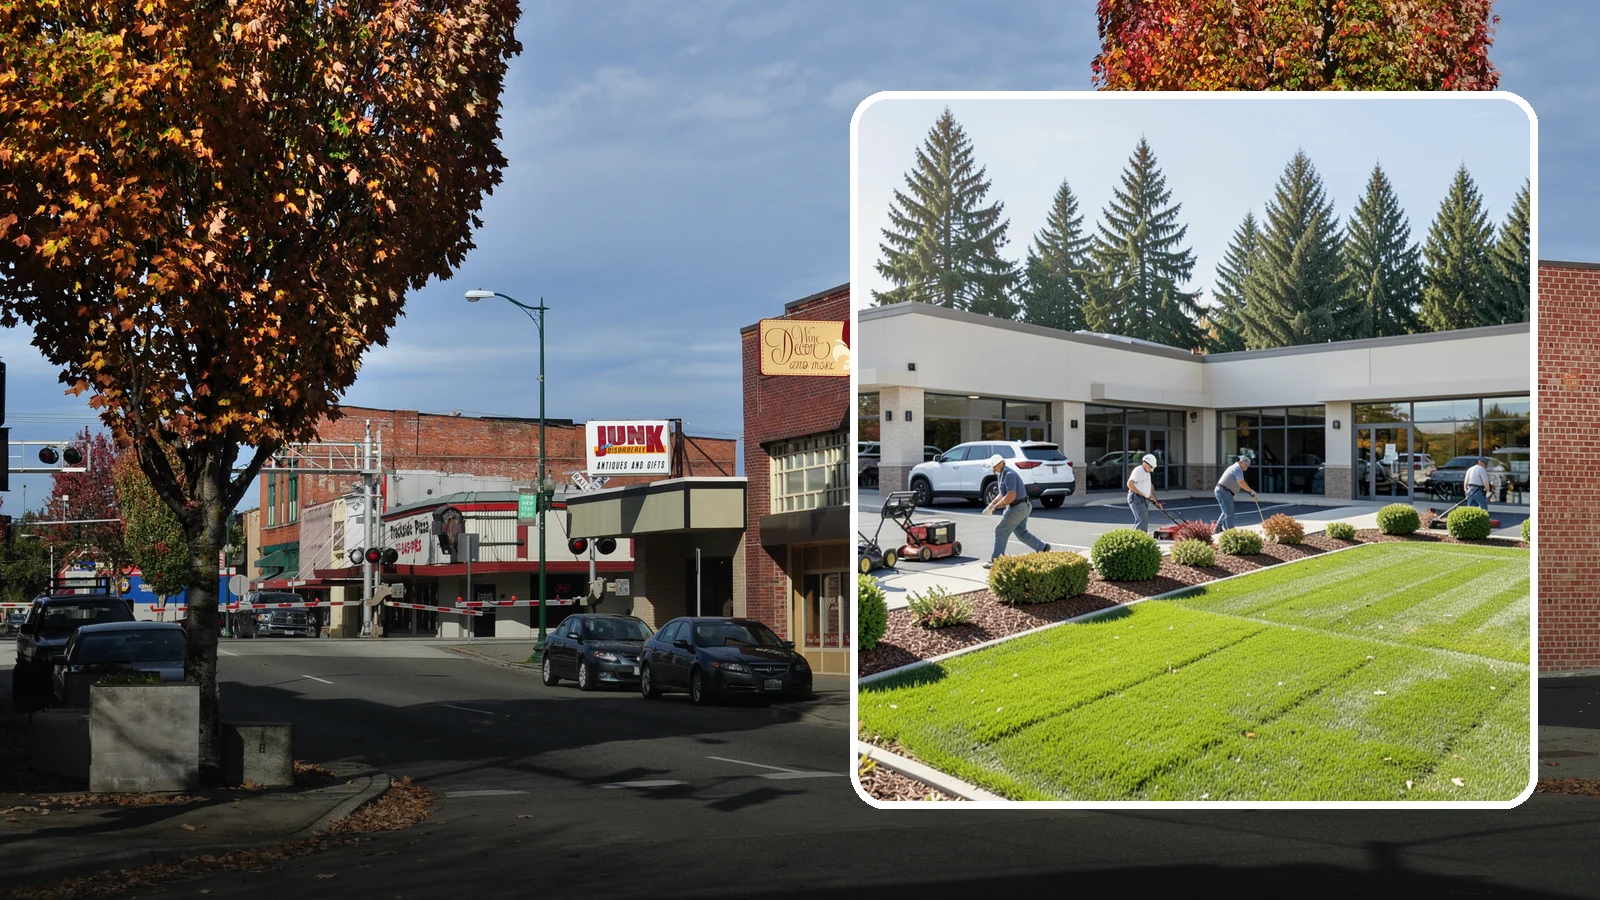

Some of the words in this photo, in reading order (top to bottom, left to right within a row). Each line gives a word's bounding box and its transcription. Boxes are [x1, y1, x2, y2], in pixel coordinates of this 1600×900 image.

[765, 328, 831, 366] Decor
[595, 425, 665, 457] JUNK
[608, 446, 646, 454] DISORDERLY
[597, 461, 628, 470] ANTIQUES
[631, 461, 644, 470] AND
[647, 460, 665, 470] GIFTS
[414, 519, 429, 536] Pizza
